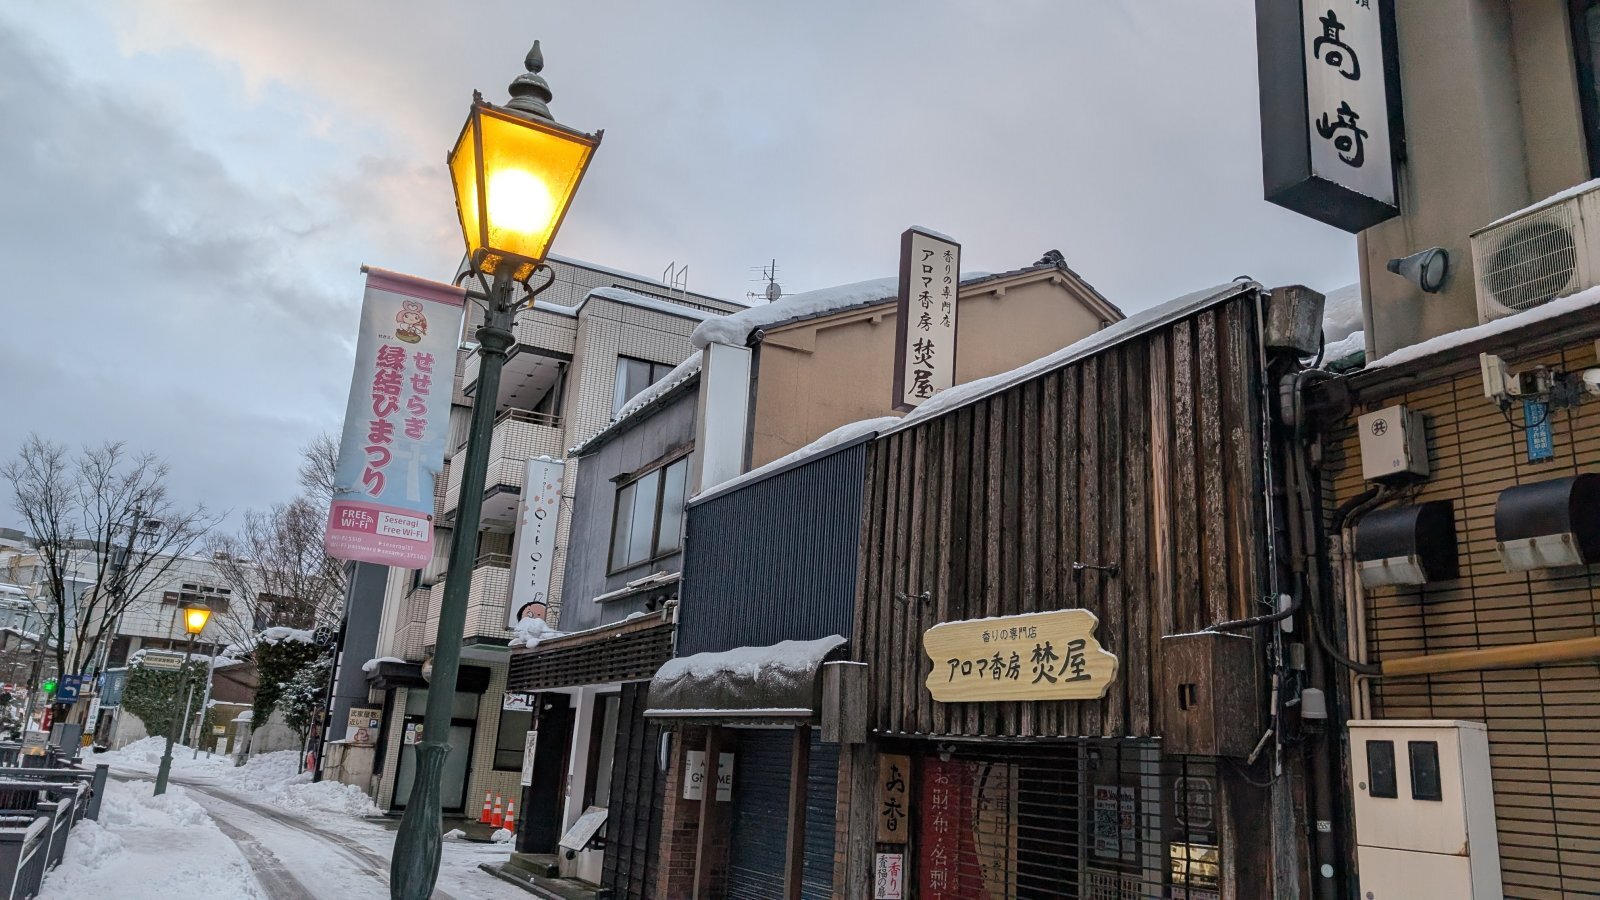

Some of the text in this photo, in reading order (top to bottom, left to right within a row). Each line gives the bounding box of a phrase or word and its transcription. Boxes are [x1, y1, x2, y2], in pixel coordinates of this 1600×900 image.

[940, 250, 954, 328] 香りの専門店
[403, 351, 435, 440] せせらぎ
[362, 344, 407, 497] 縁結びまつり
[341, 518, 369, 529] Wi-Fi
[342, 509, 367, 520] FREE
[384, 515, 419, 528] Seseragi
[383, 525, 424, 538] Free Wi-Fi
[981, 625, 1038, 644] 香りの専門店
[65, 677, 72, 685] P
[882, 763, 906, 832] お香
[888, 862, 901, 892] 香り
